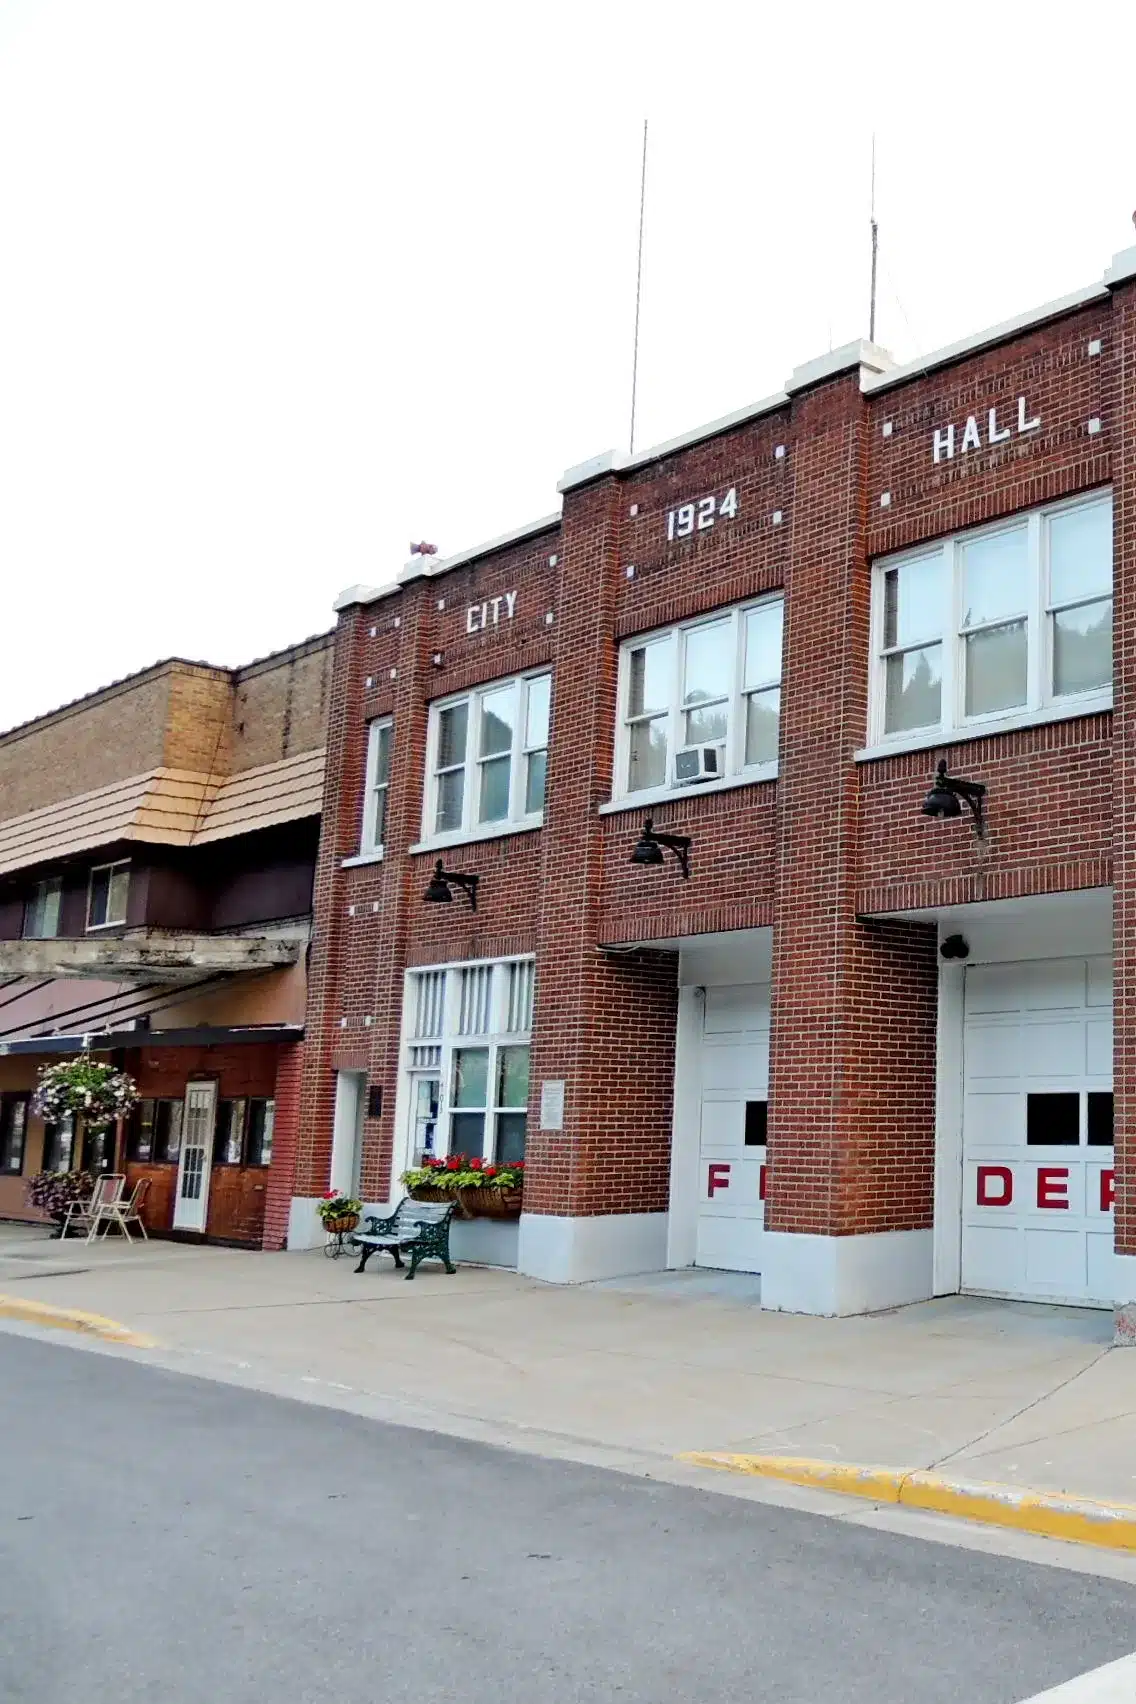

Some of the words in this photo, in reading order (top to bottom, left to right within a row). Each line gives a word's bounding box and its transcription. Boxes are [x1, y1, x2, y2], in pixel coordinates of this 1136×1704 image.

[932, 396, 1042, 464] HALL
[667, 487, 738, 541] 1924
[466, 590, 518, 634] CITY
